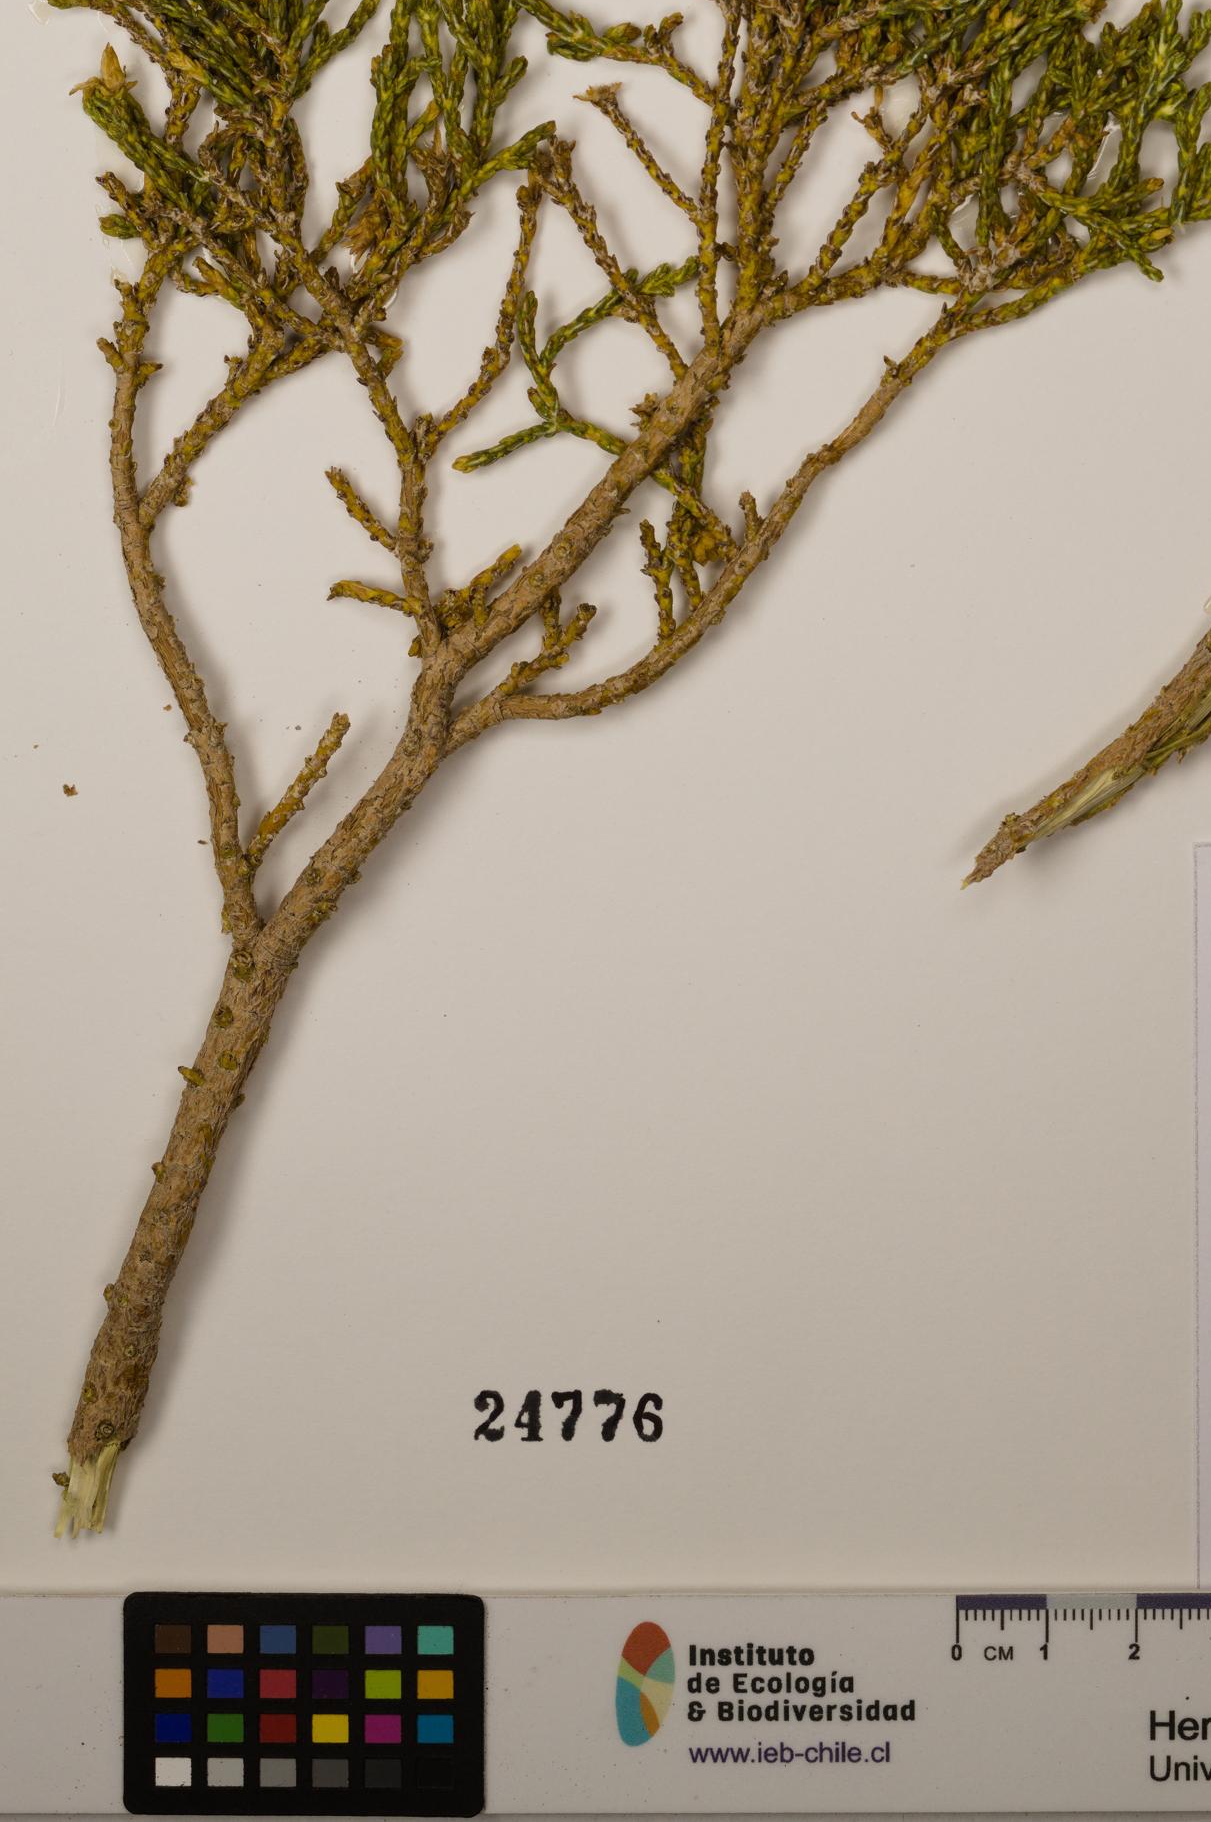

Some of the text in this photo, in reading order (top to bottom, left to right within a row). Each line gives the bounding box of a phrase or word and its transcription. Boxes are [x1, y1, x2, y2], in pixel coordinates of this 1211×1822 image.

[473, 1388, 664, 1443] 24776
[688, 1642, 815, 1667] Instituto
[951, 1643, 963, 1661] 0
[983, 1645, 1014, 1662] CM
[1039, 1643, 1050, 1661] 1
[1128, 1643, 1141, 1660] 2
[687, 1670, 855, 1698] de Ecología
[687, 1698, 916, 1723] & Biodiversidad
[688, 1740, 891, 1764] www.ieb-chile.cl
